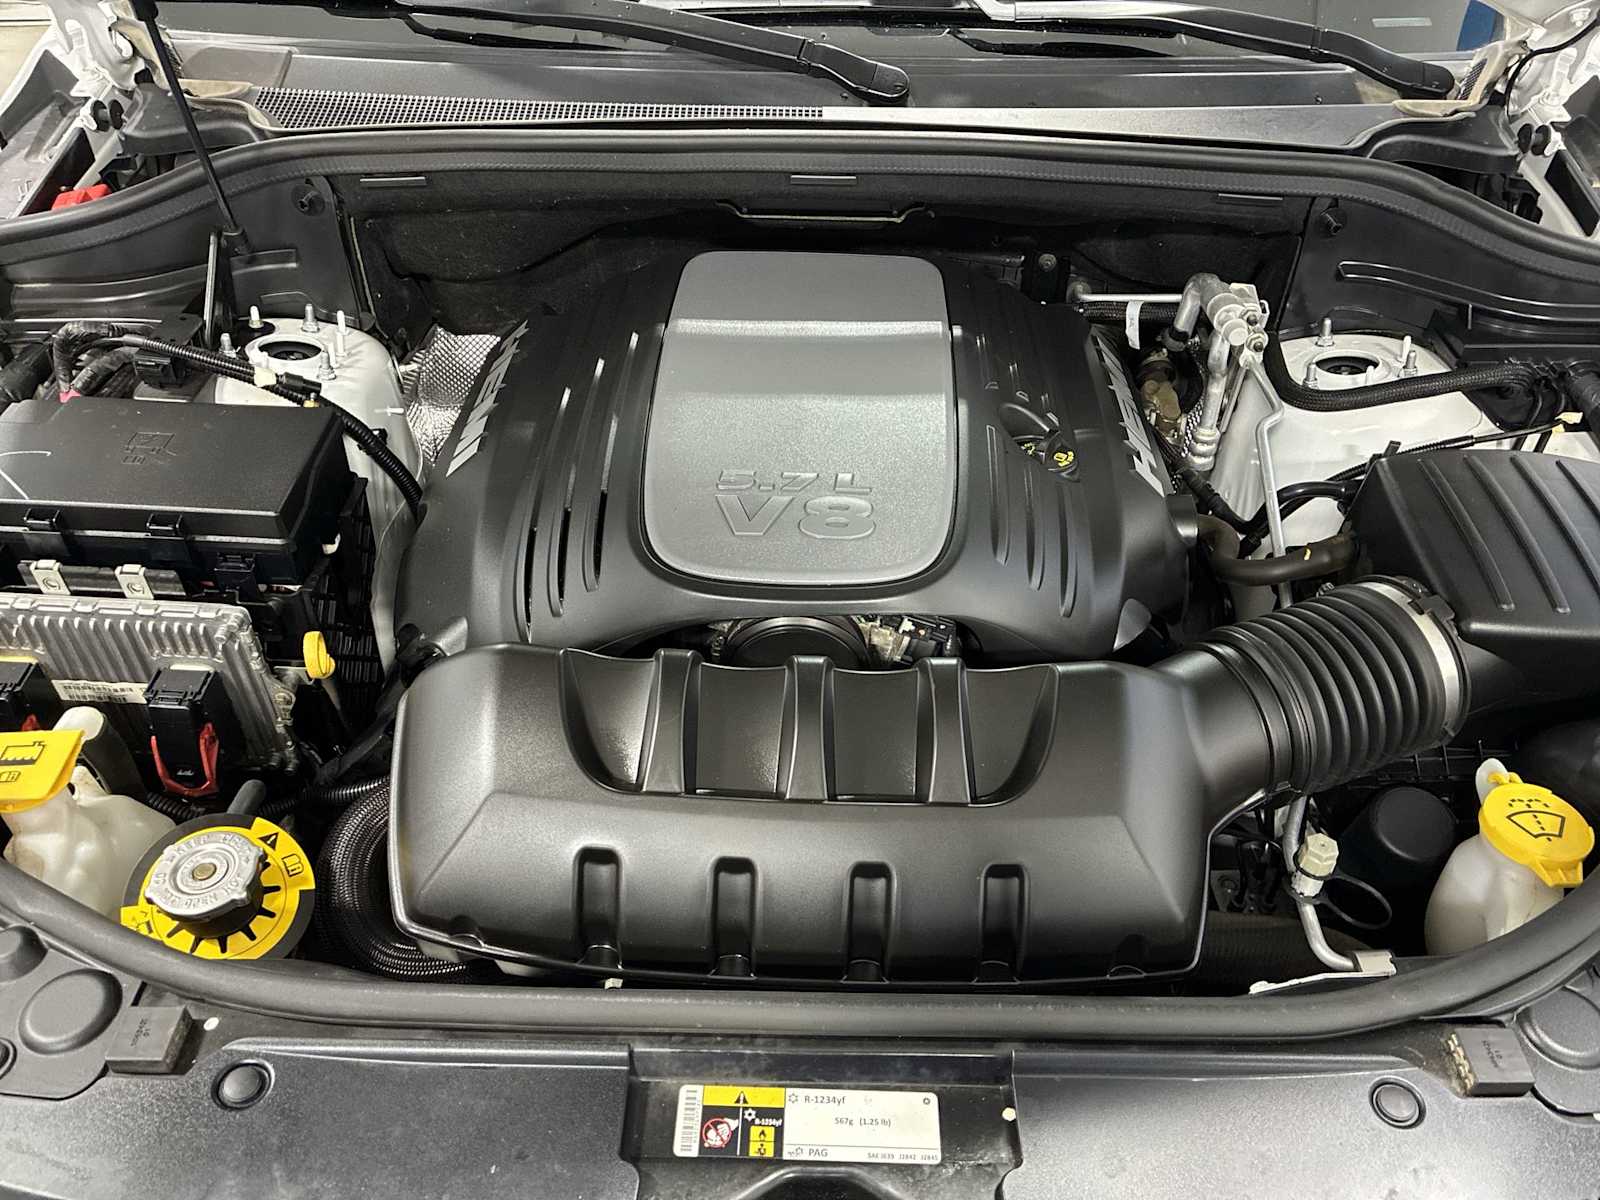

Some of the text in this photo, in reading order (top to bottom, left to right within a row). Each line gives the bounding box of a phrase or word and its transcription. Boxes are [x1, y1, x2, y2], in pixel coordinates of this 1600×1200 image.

[714, 494, 877, 540] V8
[804, 1095, 846, 1106] R-1234yf
[834, 1117, 854, 1126] 567g
[859, 1117, 880, 1127] (1.25
[808, 1148, 829, 1158] PAG
